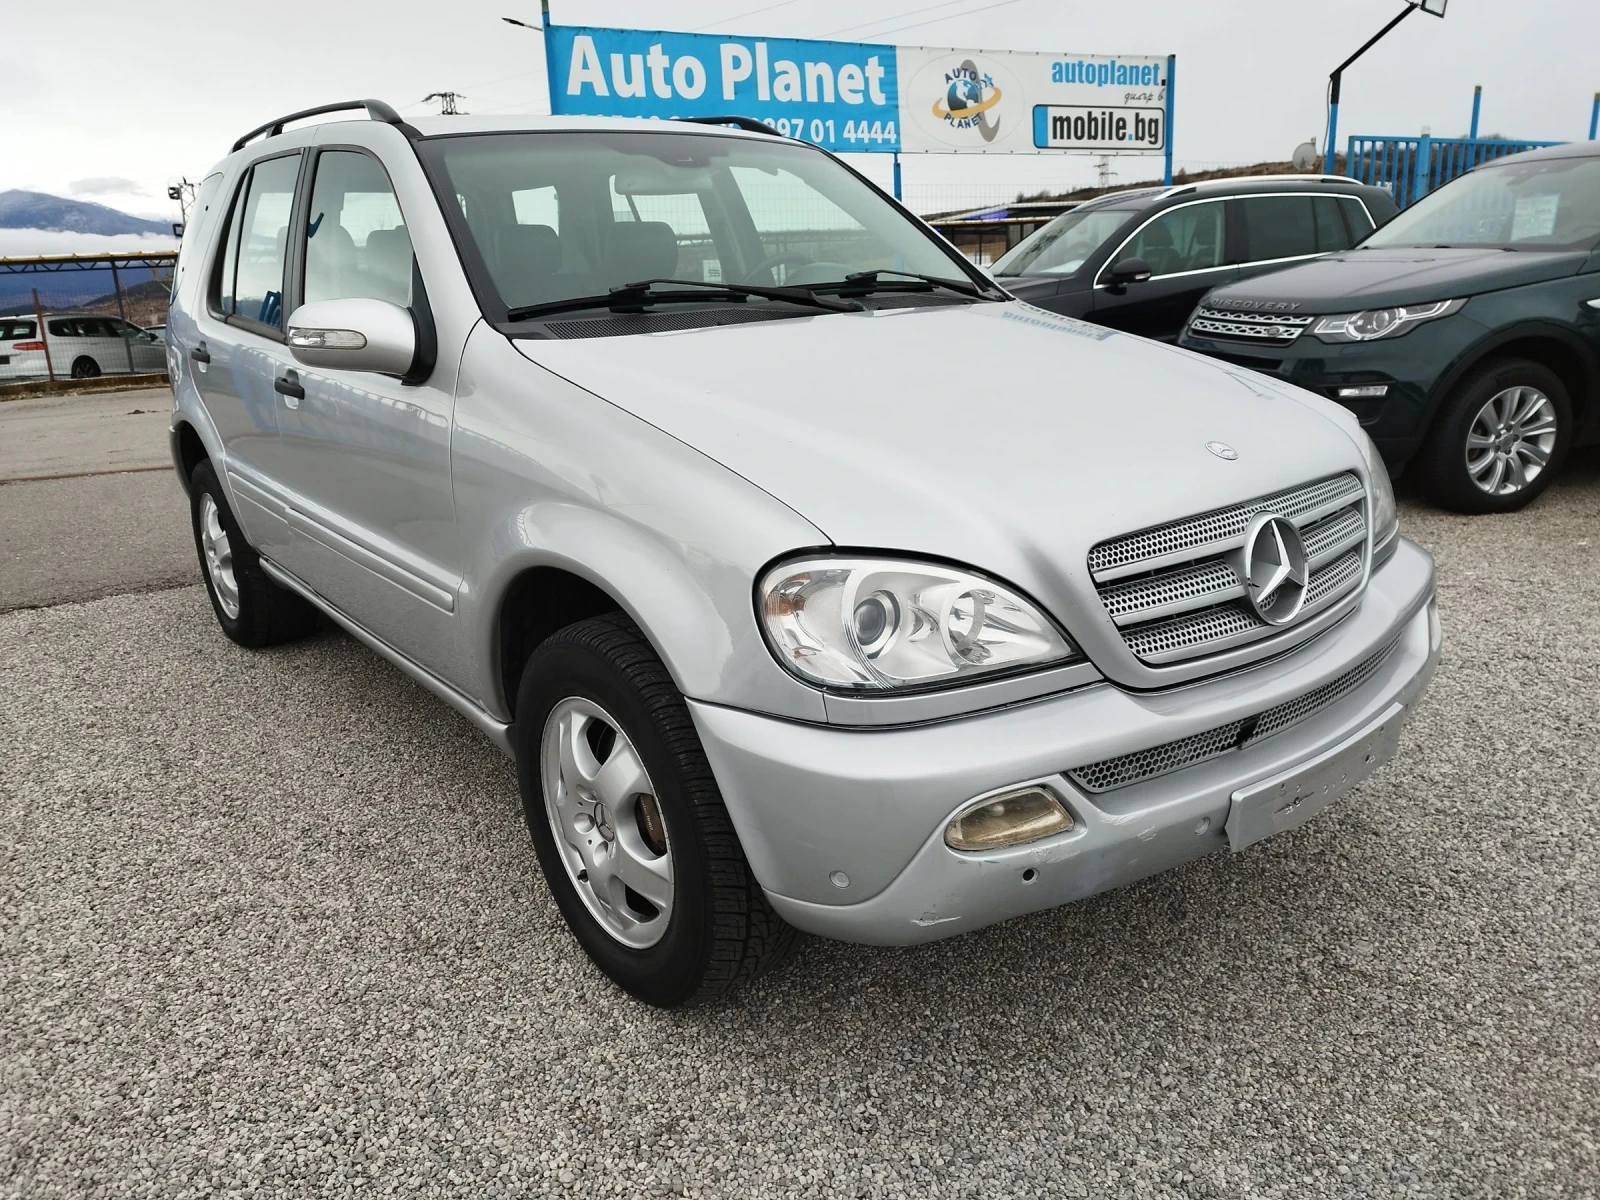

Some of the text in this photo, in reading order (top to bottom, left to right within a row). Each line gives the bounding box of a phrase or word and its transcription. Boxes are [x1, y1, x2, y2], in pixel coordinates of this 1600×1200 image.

[566, 35, 886, 106] Auto Planet
[945, 68, 977, 84] AUTO
[944, 112, 983, 129] PLANET
[1052, 111, 1159, 145] mobile.bg
[810, 119, 835, 143] 01
[843, 120, 897, 144] 4444
[1212, 298, 1301, 311] DISCOVERY
